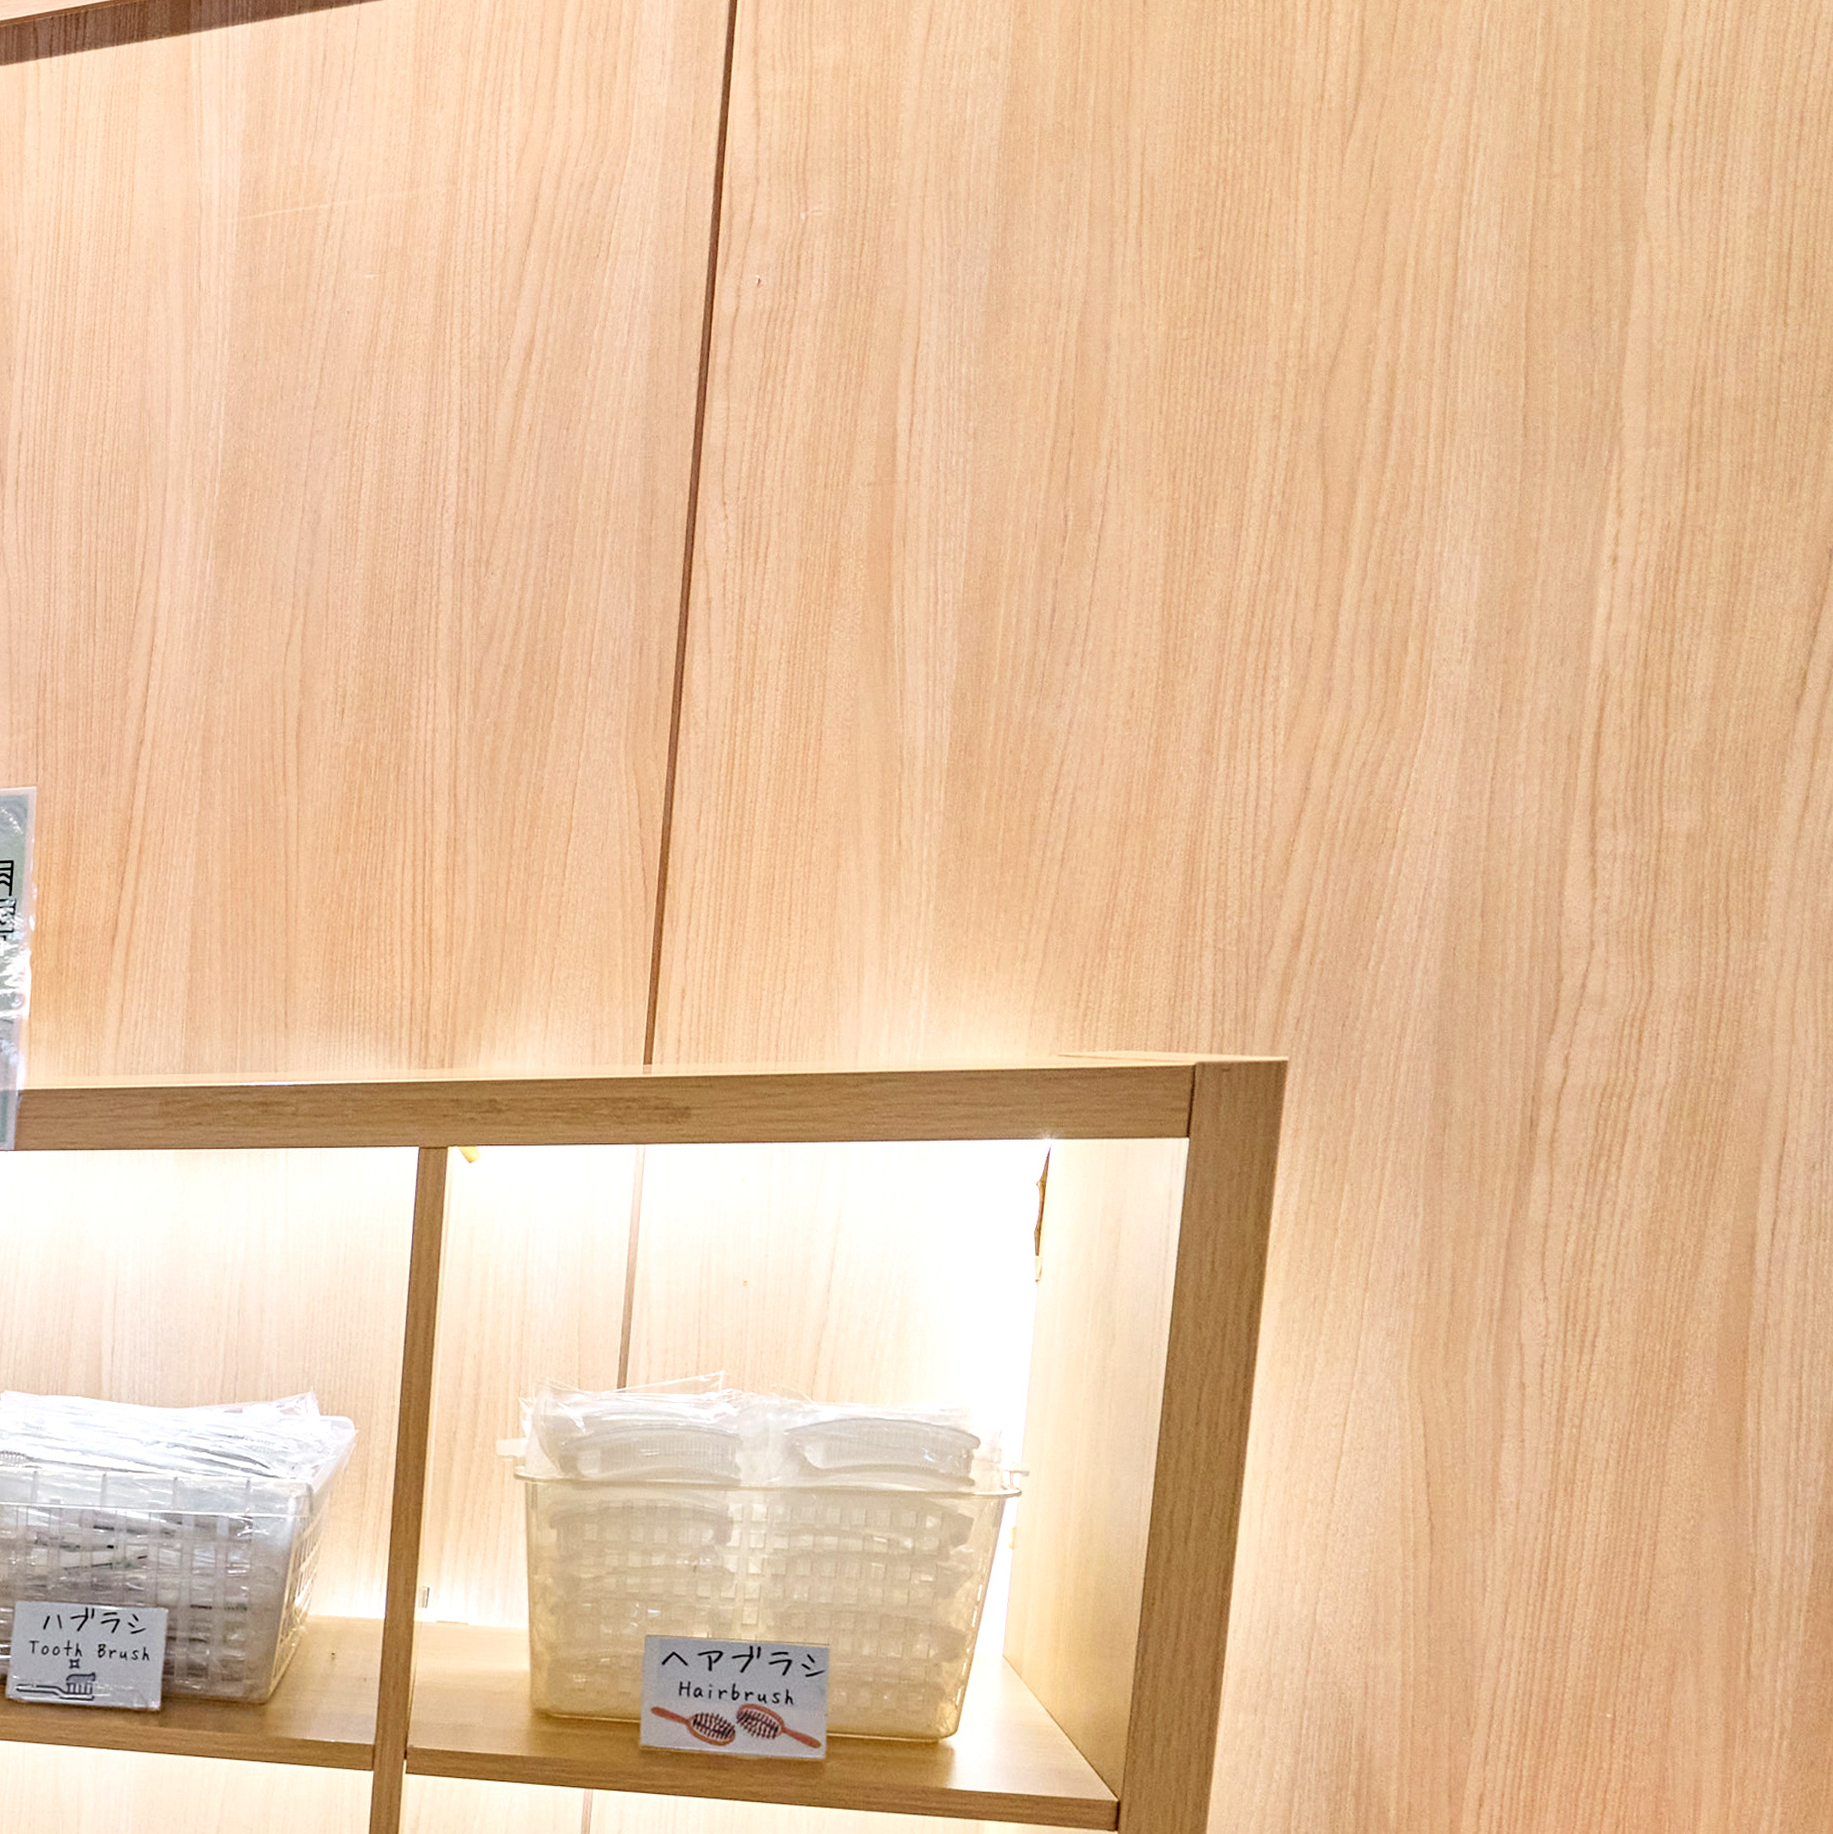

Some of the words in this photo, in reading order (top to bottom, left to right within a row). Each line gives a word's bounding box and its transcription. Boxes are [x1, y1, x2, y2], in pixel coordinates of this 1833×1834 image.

[42, 1608, 147, 1634] ハブラシ
[30, 1640, 82, 1658] Tooth
[97, 1643, 150, 1661] Brush
[662, 1646, 825, 1677] ヘアブラシ
[678, 1681, 795, 1705] Hairbrush
